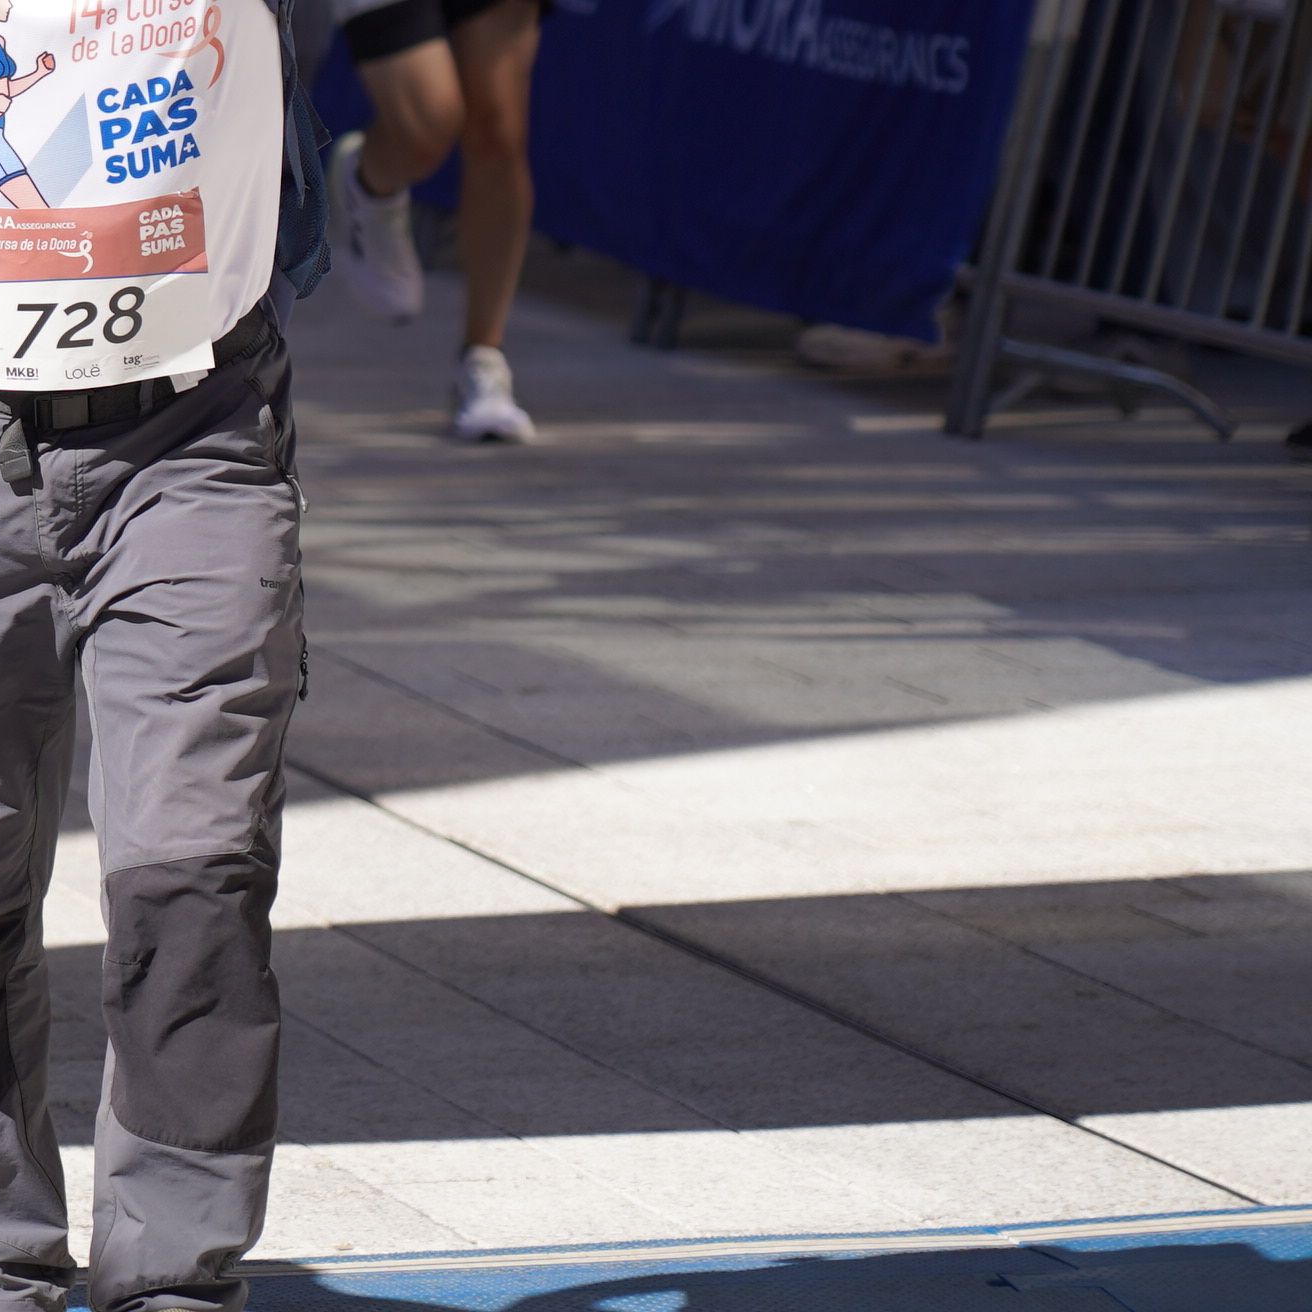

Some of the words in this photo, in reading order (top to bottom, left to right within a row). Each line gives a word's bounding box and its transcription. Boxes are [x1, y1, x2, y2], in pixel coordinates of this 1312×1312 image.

[72, 36, 99, 63] de
[111, 31, 133, 56] la
[140, 16, 197, 51] Dona
[97, 69, 194, 113] CADA
[99, 97, 198, 150] PAS
[105, 133, 201, 184] SUMA
[16, 222, 76, 230] ASSEGURANCES
[139, 204, 183, 224] CADA
[139, 218, 185, 241] PAS
[20, 239, 34, 250] de
[37, 239, 48, 250] la
[49, 238, 77, 250] Dona
[141, 236, 186, 256] SUMA
[12, 286, 145, 359] 728
